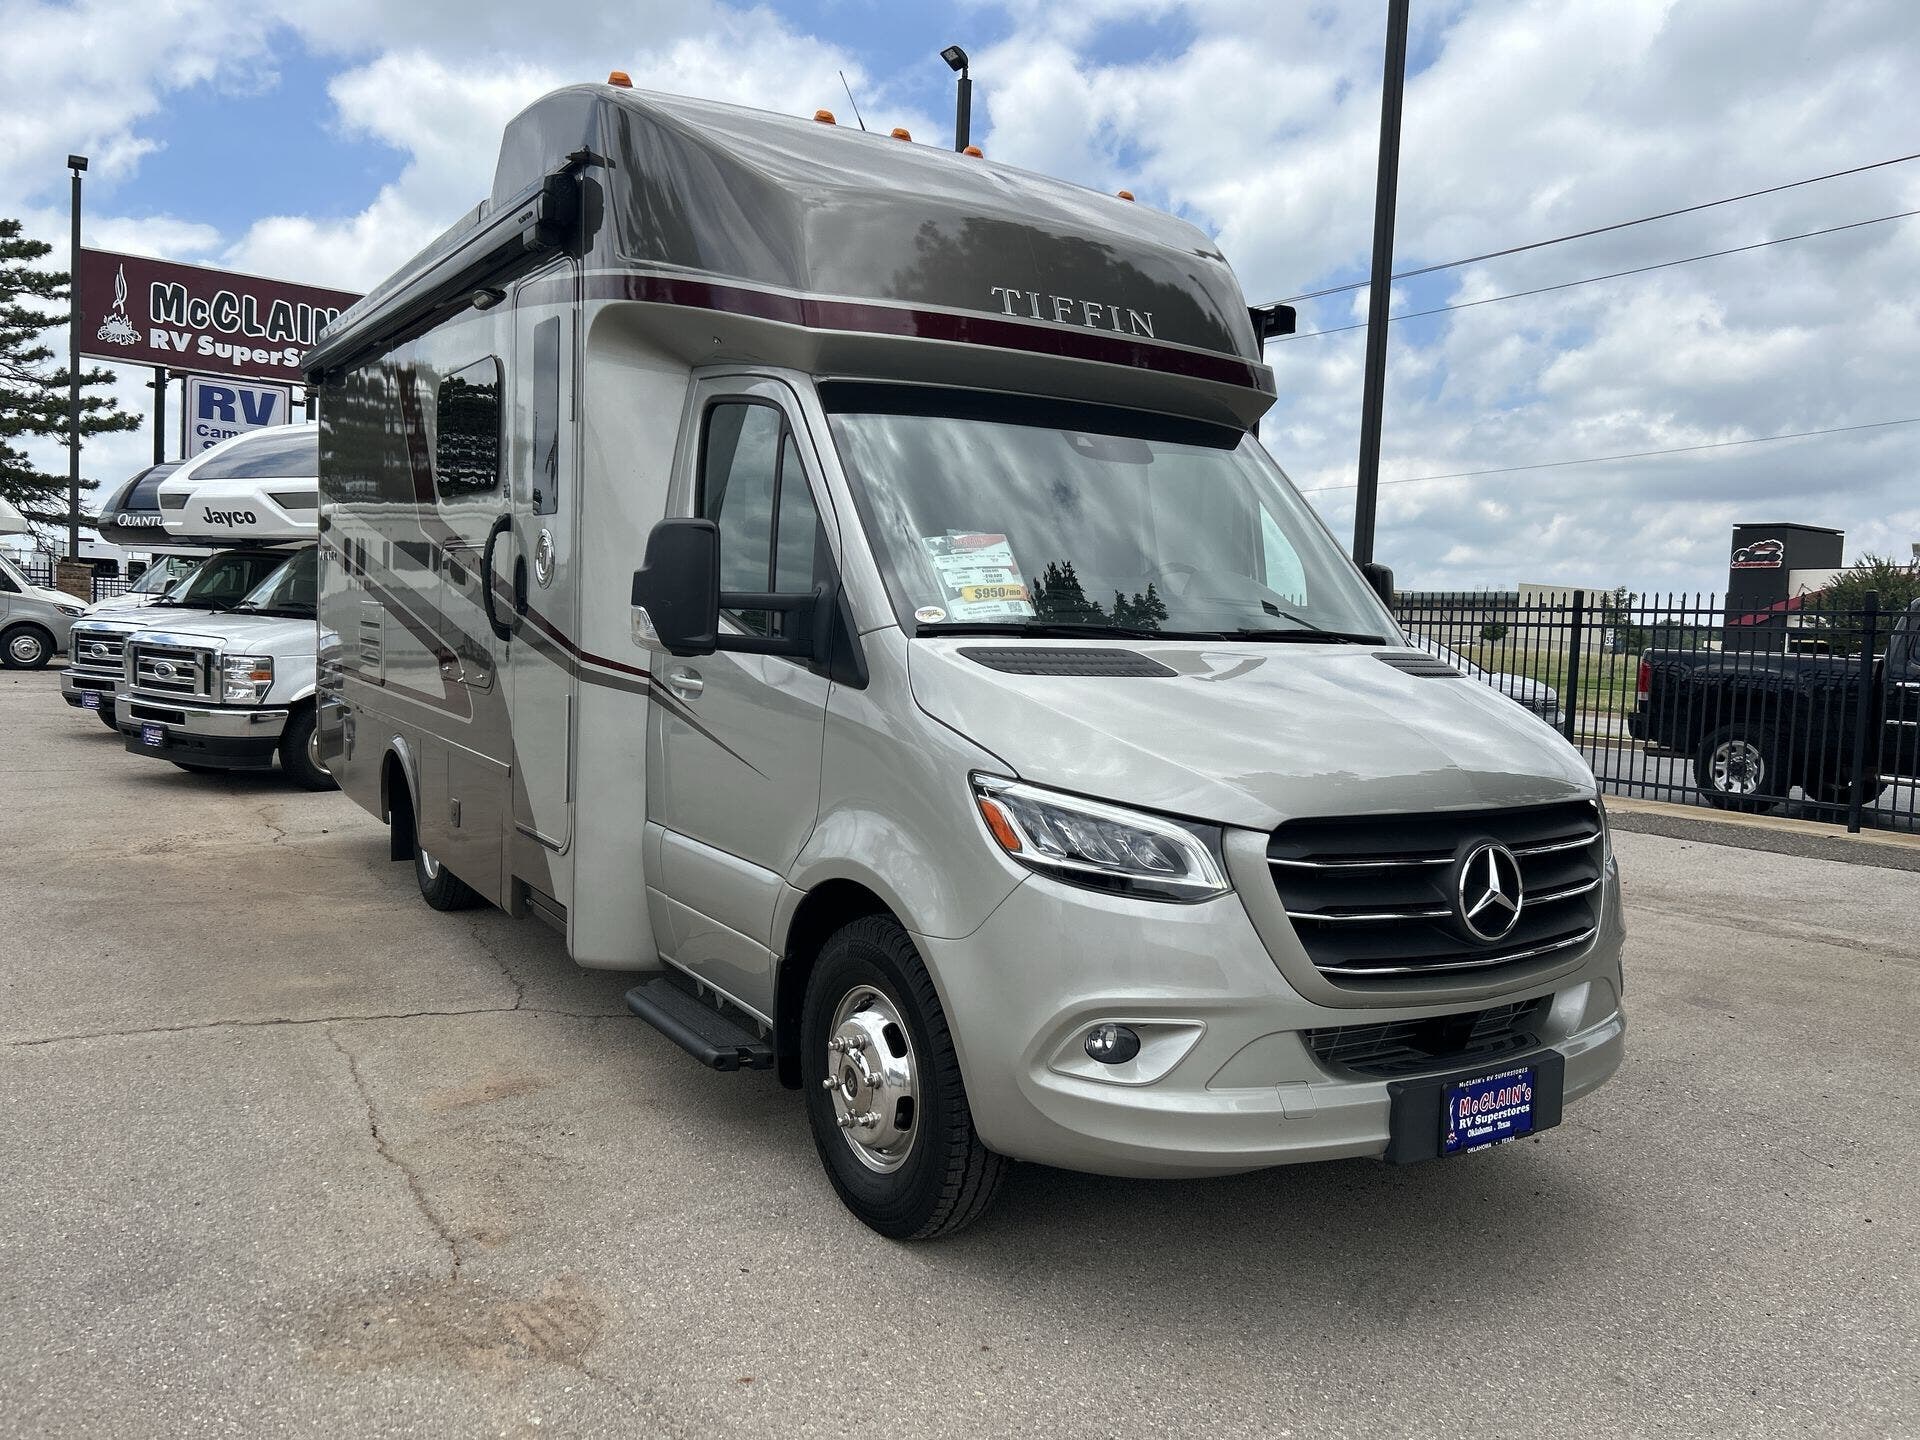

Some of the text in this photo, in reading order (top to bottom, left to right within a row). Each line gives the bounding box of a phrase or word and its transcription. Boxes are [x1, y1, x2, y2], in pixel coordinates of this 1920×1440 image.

[990, 285, 1155, 338] TIFFIN
[149, 328, 307, 368] RV SuperS
[198, 384, 277, 426] RV
[196, 424, 244, 438] Cam
[203, 506, 257, 528] Jayco
[1494, 1067, 1528, 1079] SUPERSTORES
[1458, 1104, 1530, 1130] RV Superstores
[1467, 1121, 1511, 1138] Oklahoma Texas
[1466, 1136, 1516, 1153] OKLAHOMA TEXAS
